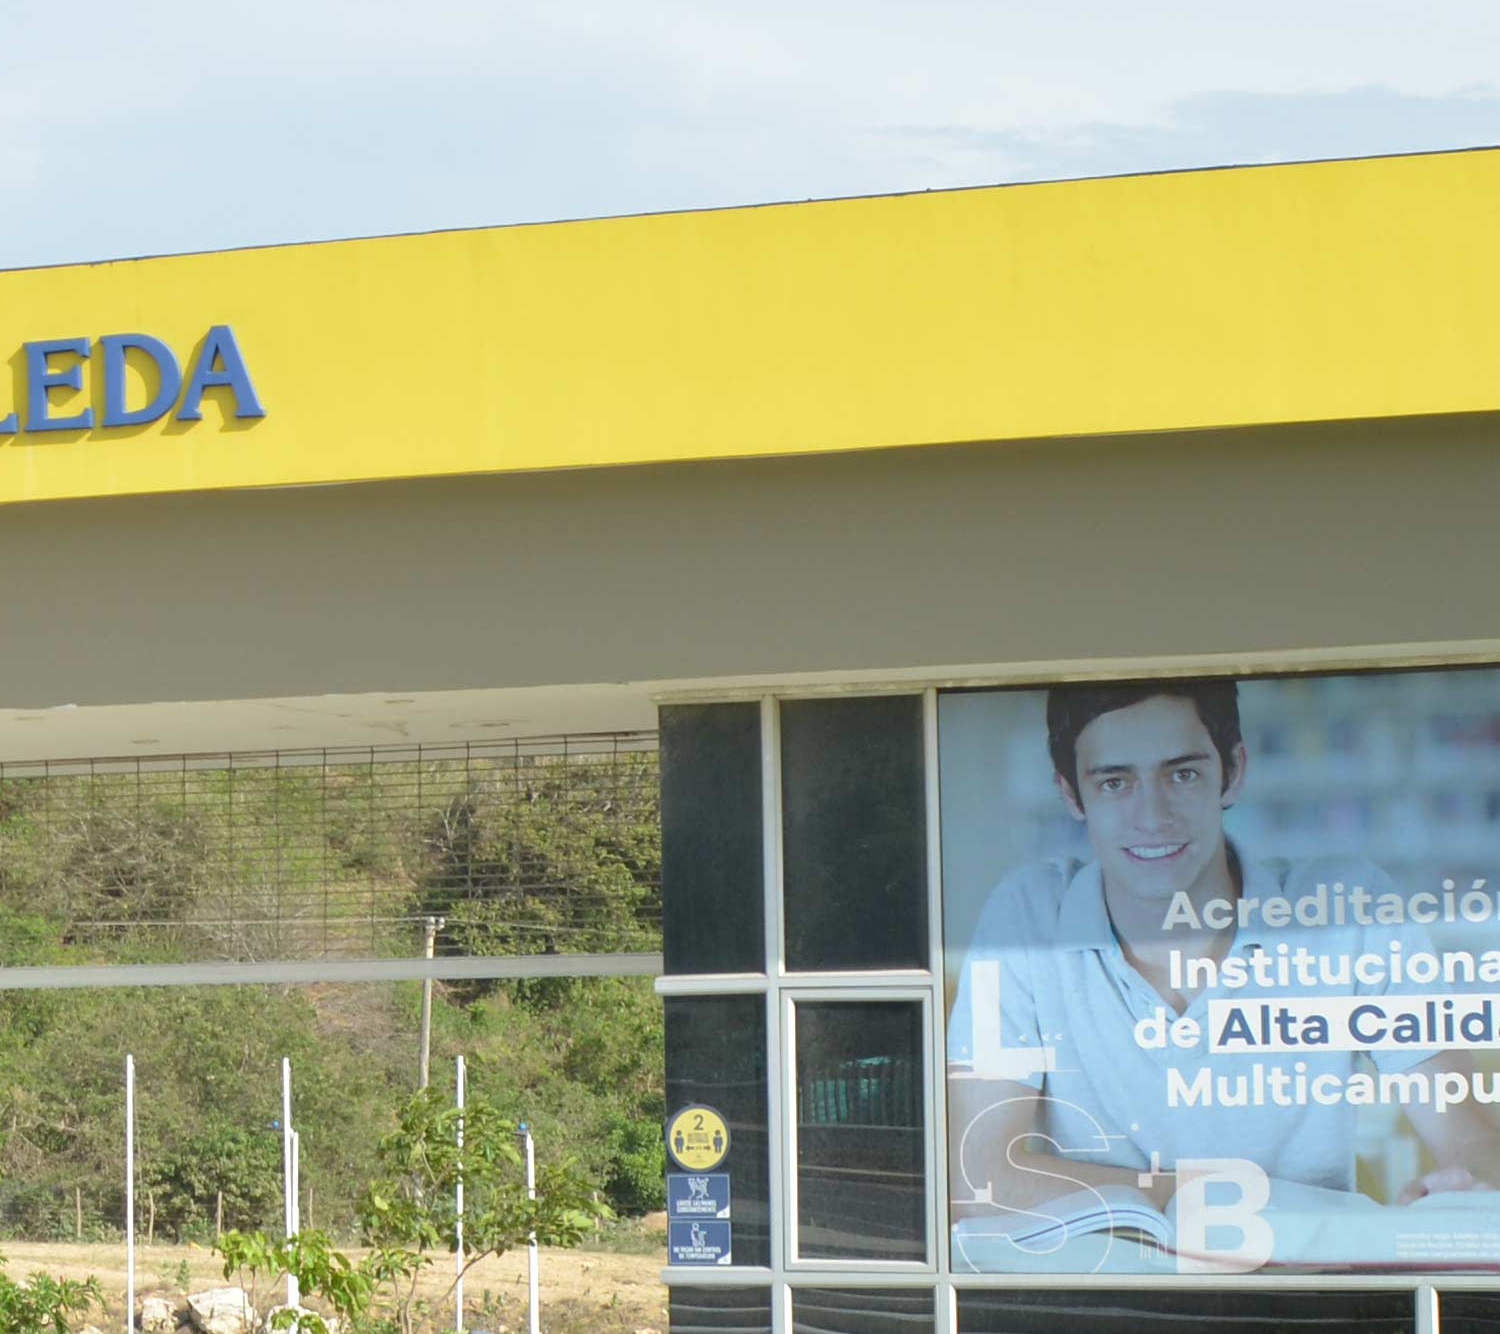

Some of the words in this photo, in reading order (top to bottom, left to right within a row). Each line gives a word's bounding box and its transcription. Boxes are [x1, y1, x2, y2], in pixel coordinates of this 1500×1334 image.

[1134, 1006, 1201, 1049] de
[1217, 1004, 1330, 1047] Alta
[693, 1113, 704, 1131] 2
